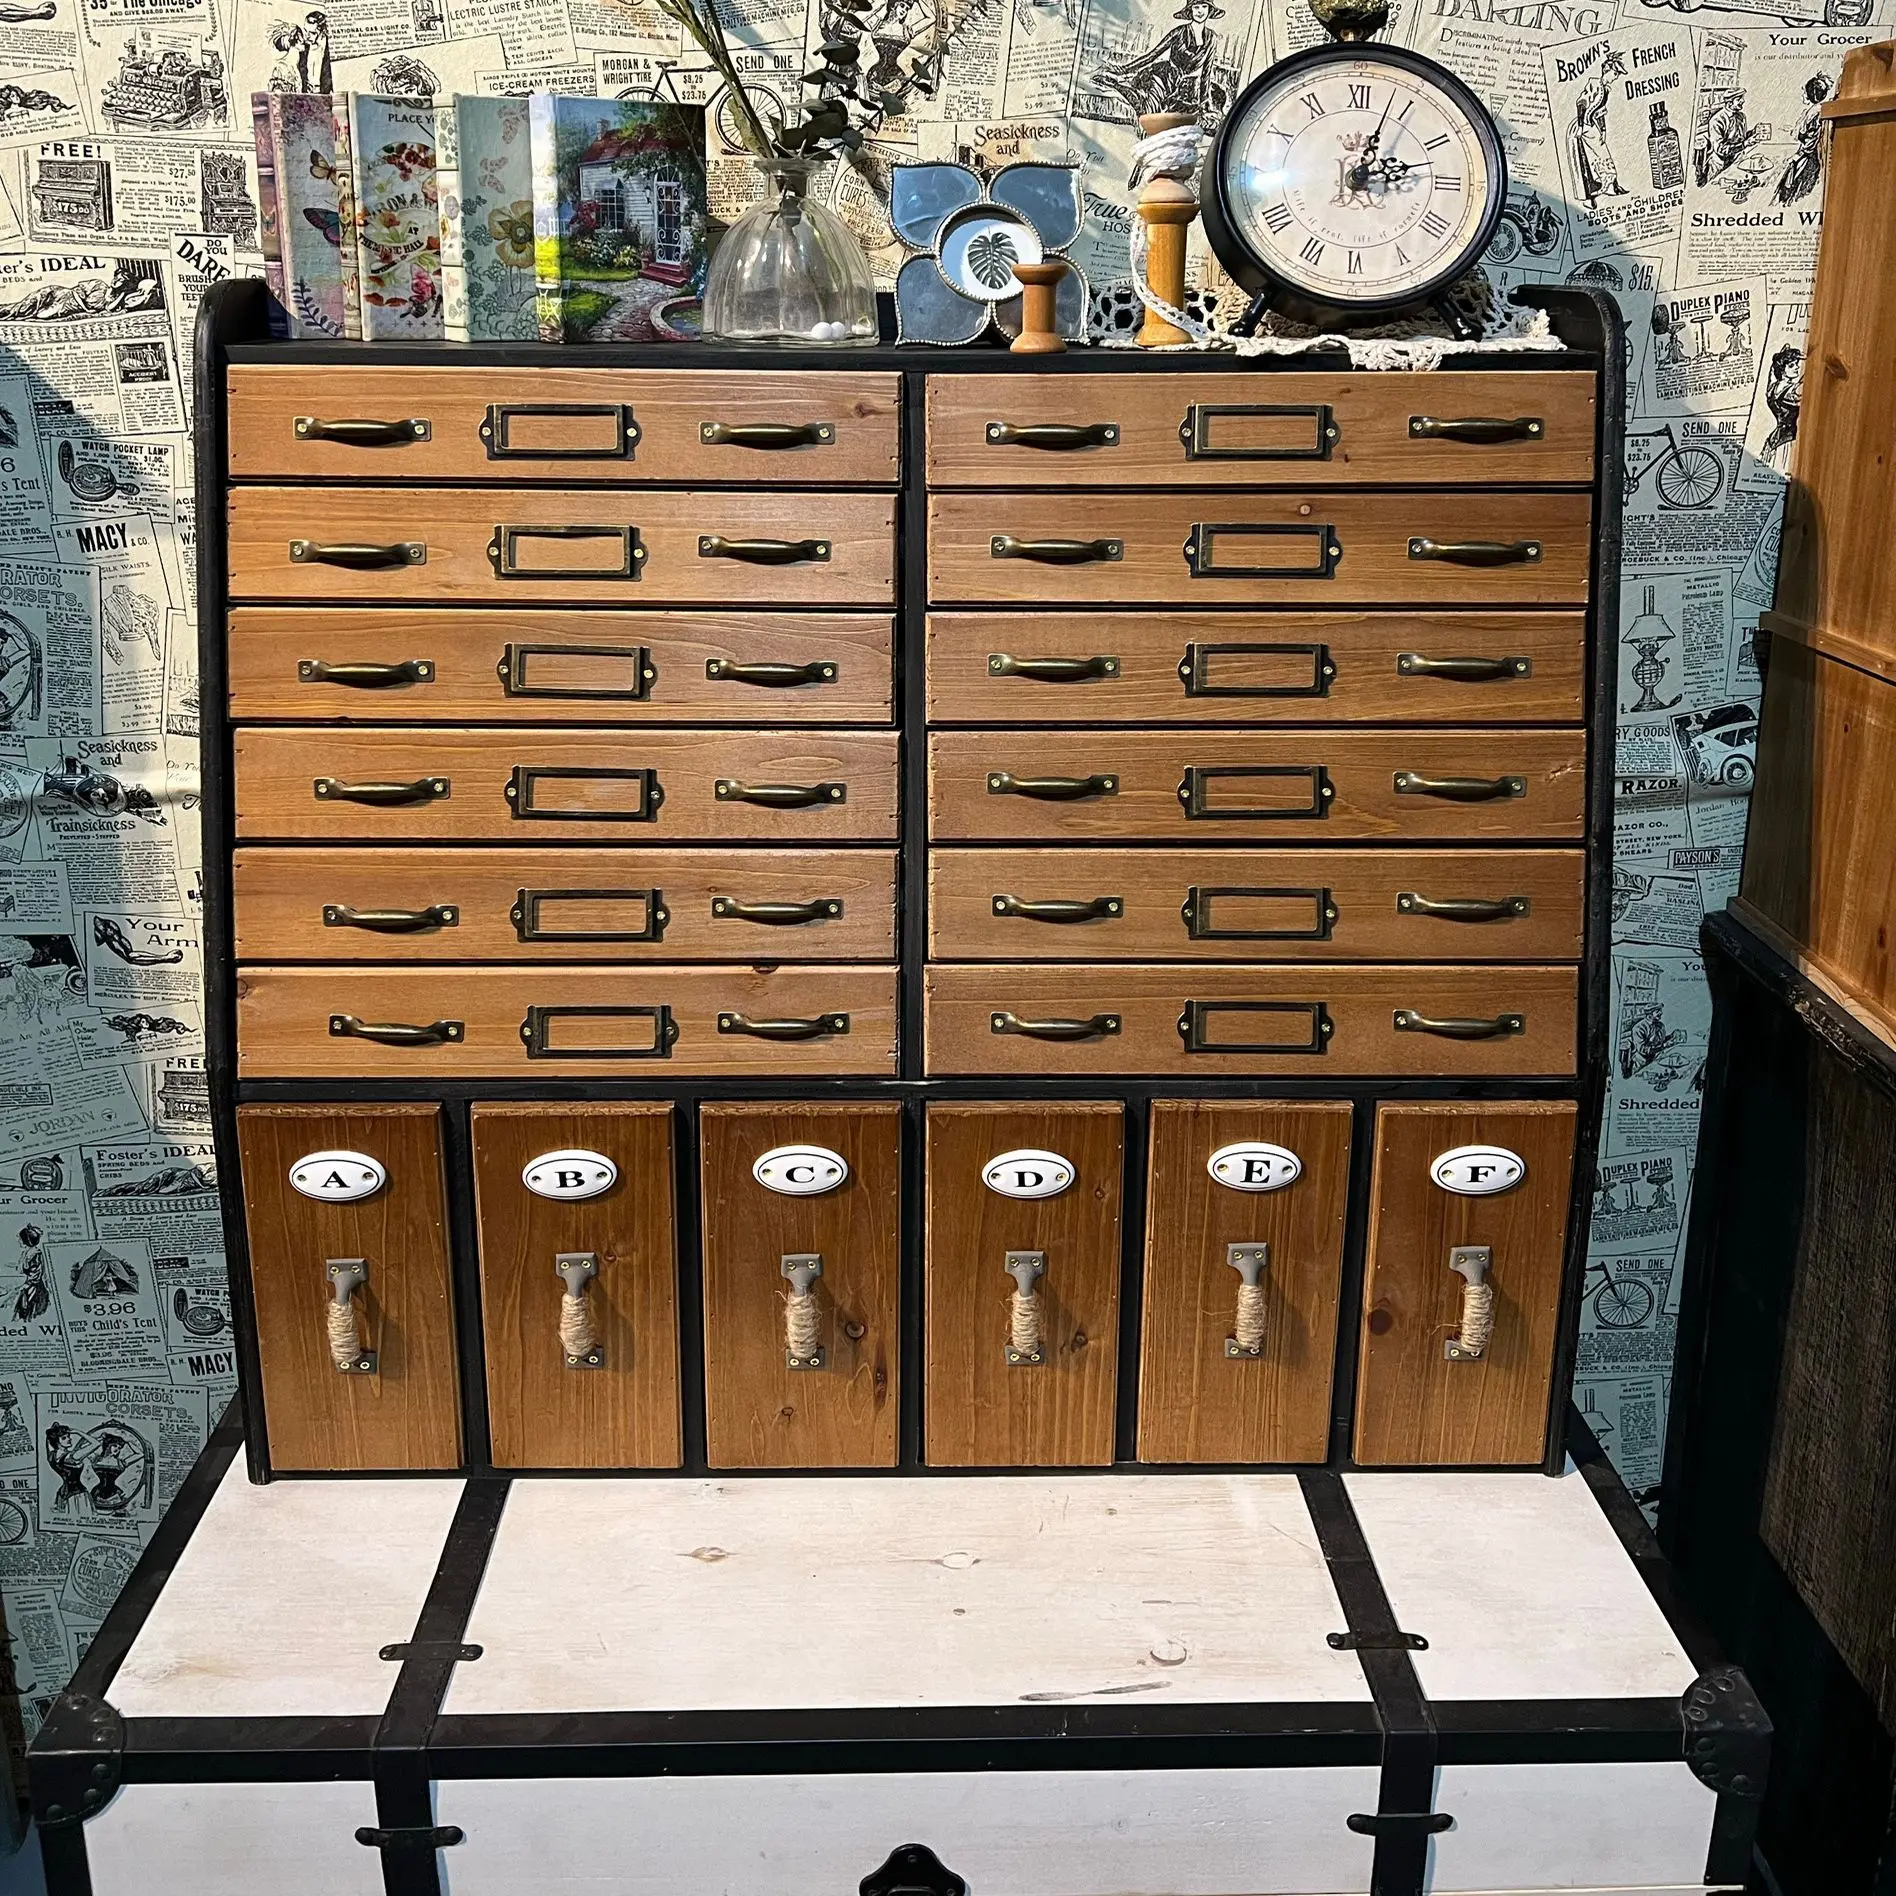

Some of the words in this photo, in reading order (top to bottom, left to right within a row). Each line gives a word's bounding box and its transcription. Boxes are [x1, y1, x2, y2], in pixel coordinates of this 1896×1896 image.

[450, 7, 485, 20] LECTRIC
[489, 1, 521, 15] LUSTRE
[539, 23, 566, 31] Electric
[1440, 28, 1503, 43] DISCRIMINATING
[1769, 33, 1807, 45] Your
[1817, 33, 1872, 45] Grocer
[1556, 39, 1611, 83] BROWN'S
[1632, 42, 1676, 69] FRENCH
[602, 59, 639, 70] MORGAN
[643, 58, 651, 69] &
[736, 55, 764, 73] SEND
[773, 55, 793, 69] ONE
[1352, 62, 1369, 70] 60
[489, 79, 542, 91] ICE-CREAM
[546, 75, 594, 86] FREEZERS
[602, 72, 632, 84] WRIGHT
[636, 72, 652, 83] TIRE
[683, 75, 703, 84] $8.25
[1625, 72, 1680, 101] DRESSING
[682, 91, 706, 100] $23.75
[1346, 83, 1372, 109] XII
[1300, 92, 1326, 119] XI
[1397, 100, 1414, 121] I
[388, 113, 423, 124] PLACE
[974, 123, 1061, 147] Seasickness
[1266, 124, 1294, 145] X
[1461, 121, 1473, 135] 10
[1423, 133, 1451, 151] II
[1510, 132, 1545, 146] Company
[41, 143, 101, 158] FREE!
[996, 140, 1020, 156] and
[169, 168, 196, 178] $27.50
[844, 174, 865, 188] CORN
[1435, 176, 1461, 192] III
[1476, 180, 1486, 192] 15
[165, 196, 196, 206] $175.00
[840, 184, 868, 209] CURES
[709, 206, 732, 214] BUCK
[1084, 192, 1128, 220] True
[1576, 206, 1614, 222] LADIES'
[1588, 214, 1621, 226] BOOTS
[1626, 208, 1645, 218] AND
[1650, 199, 1683, 211] SHOES
[1262, 202, 1294, 235] VIII
[1418, 210, 1450, 240] IIII
[1691, 212, 1783, 226] Shredded
[1456, 234, 1470, 247] 20
[204, 247, 227, 255] YOU
[1299, 237, 1325, 266] VII
[1395, 242, 1411, 266] V
[41, 257, 106, 272] IDEAL
[1348, 250, 1364, 274] VI
[1629, 263, 1654, 291] $15.
[1670, 295, 1711, 322] DUPLEX
[1714, 289, 1750, 314] PIANO
[1682, 422, 1710, 438] SEND
[1718, 421, 1737, 434] ONE
[82, 441, 109, 451] WATCH
[114, 445, 143, 455] POCKET
[148, 446, 169, 456] LAMP
[1631, 439, 1651, 448] $8.25
[1627, 453, 1651, 462] $23.75
[76, 523, 128, 553] MACY
[131, 538, 136, 546] &
[137, 537, 150, 546] CO.
[1634, 727, 1670, 738] GOODS
[77, 739, 158, 759] Seasickness
[100, 753, 123, 767] and
[1621, 778, 1683, 795] RAZOR.
[46, 817, 136, 833] Trainsickness
[1675, 850, 1720, 864] PAYSON'S
[125, 918, 184, 932] Your
[147, 934, 199, 948] Arm
[1618, 1098, 1700, 1110] Shredded
[29, 1110, 96, 1136] JORDAN
[96, 1148, 158, 1161] Foster's
[163, 1144, 215, 1158] IDEAL
[784, 1165, 817, 1184] C
[1239, 1159, 1272, 1185] E
[1464, 1165, 1496, 1183] F
[1602, 1162, 1638, 1182] DUPLEX
[1641, 1157, 1672, 1177] PIANO
[319, 1170, 351, 1189] A
[554, 1170, 586, 1189] B
[1013, 1171, 1045, 1189] D
[20, 1196, 69, 1204] Grocer
[1616, 1259, 1641, 1272] SEND
[1648, 1259, 1665, 1269] ONE
[83, 1302, 136, 1316] $3.96
[93, 1318, 129, 1330] Child's
[187, 1352, 233, 1377] MACY
[105, 1403, 193, 1420] CORSETS.
[13, 1478, 30, 1488] ONE
